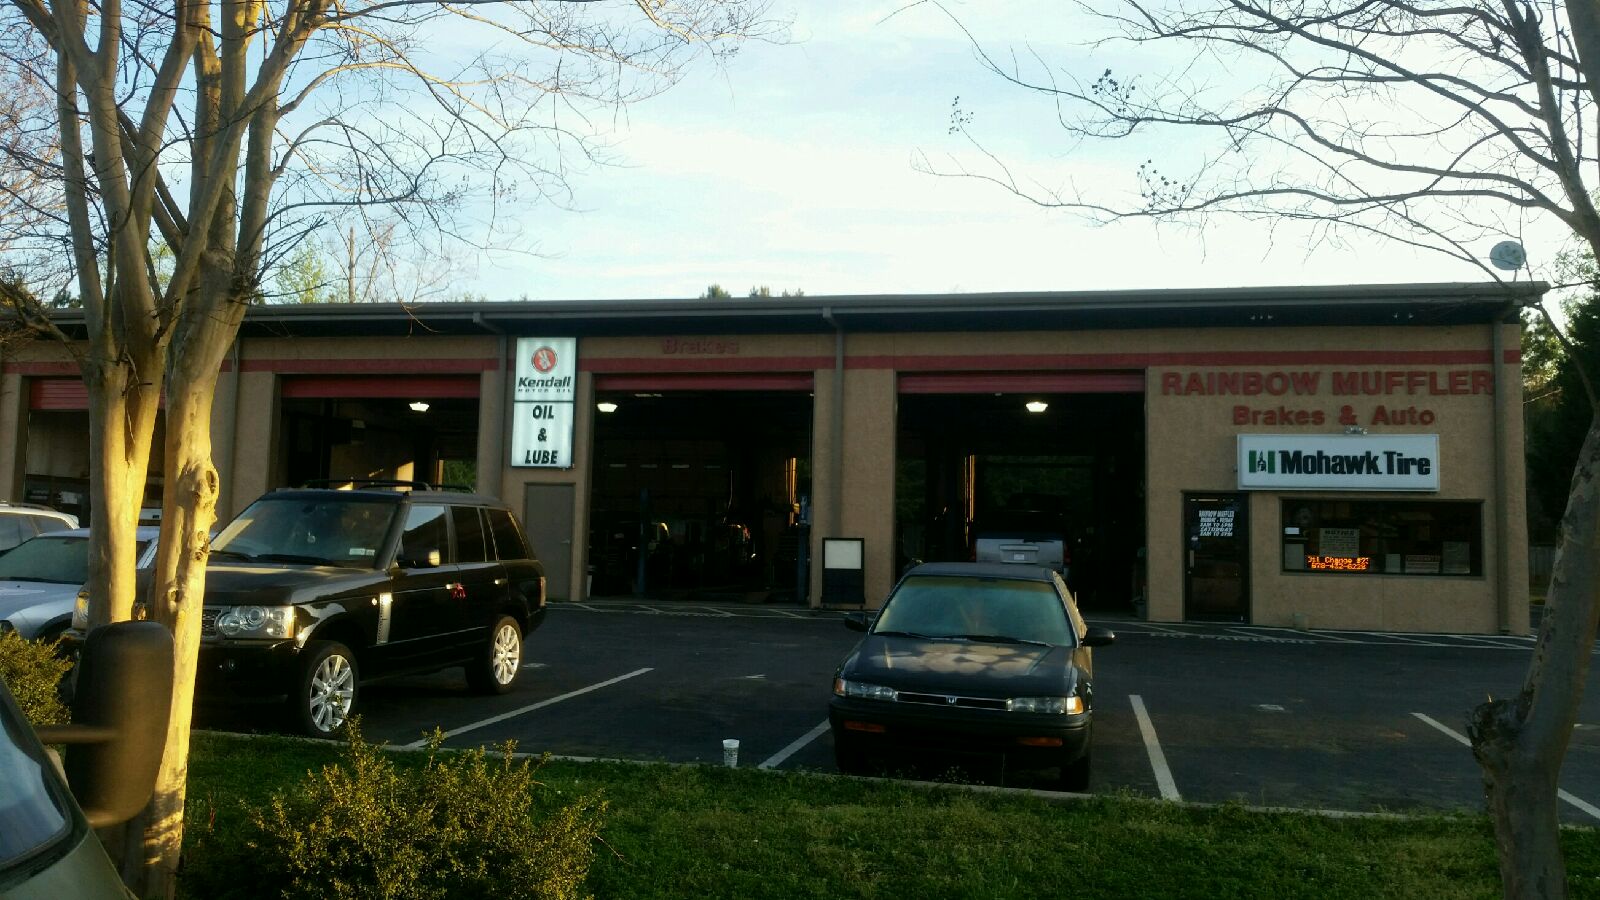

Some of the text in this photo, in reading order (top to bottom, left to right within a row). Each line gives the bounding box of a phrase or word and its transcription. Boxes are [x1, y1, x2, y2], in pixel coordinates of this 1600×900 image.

[662, 337, 738, 355] Brakes
[518, 376, 571, 388] Kendall
[1161, 371, 1494, 396] RAINBOW MUFFLER
[532, 404, 555, 419] OIL
[1233, 405, 1436, 426] Brakes & Auto
[537, 428, 547, 442] &
[524, 450, 559, 464] LUBE
[1278, 450, 1431, 475] Mohawk Tire
[1324, 556, 1353, 564] Change
